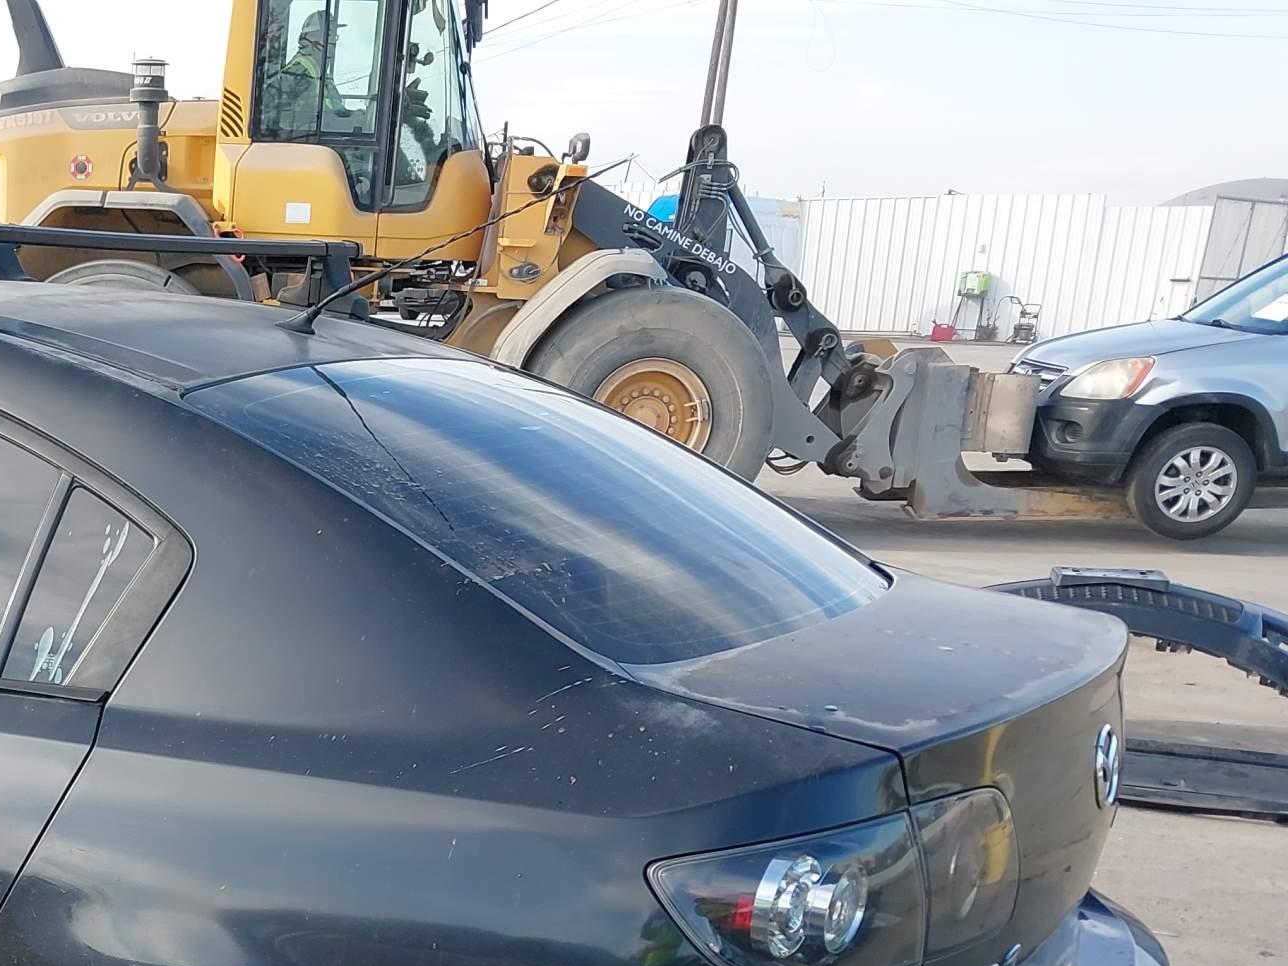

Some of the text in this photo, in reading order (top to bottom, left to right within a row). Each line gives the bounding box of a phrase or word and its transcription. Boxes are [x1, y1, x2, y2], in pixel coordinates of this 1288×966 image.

[71, 110, 140, 122] VOLV
[623, 204, 736, 274] NO CAMINE DEBAJO
